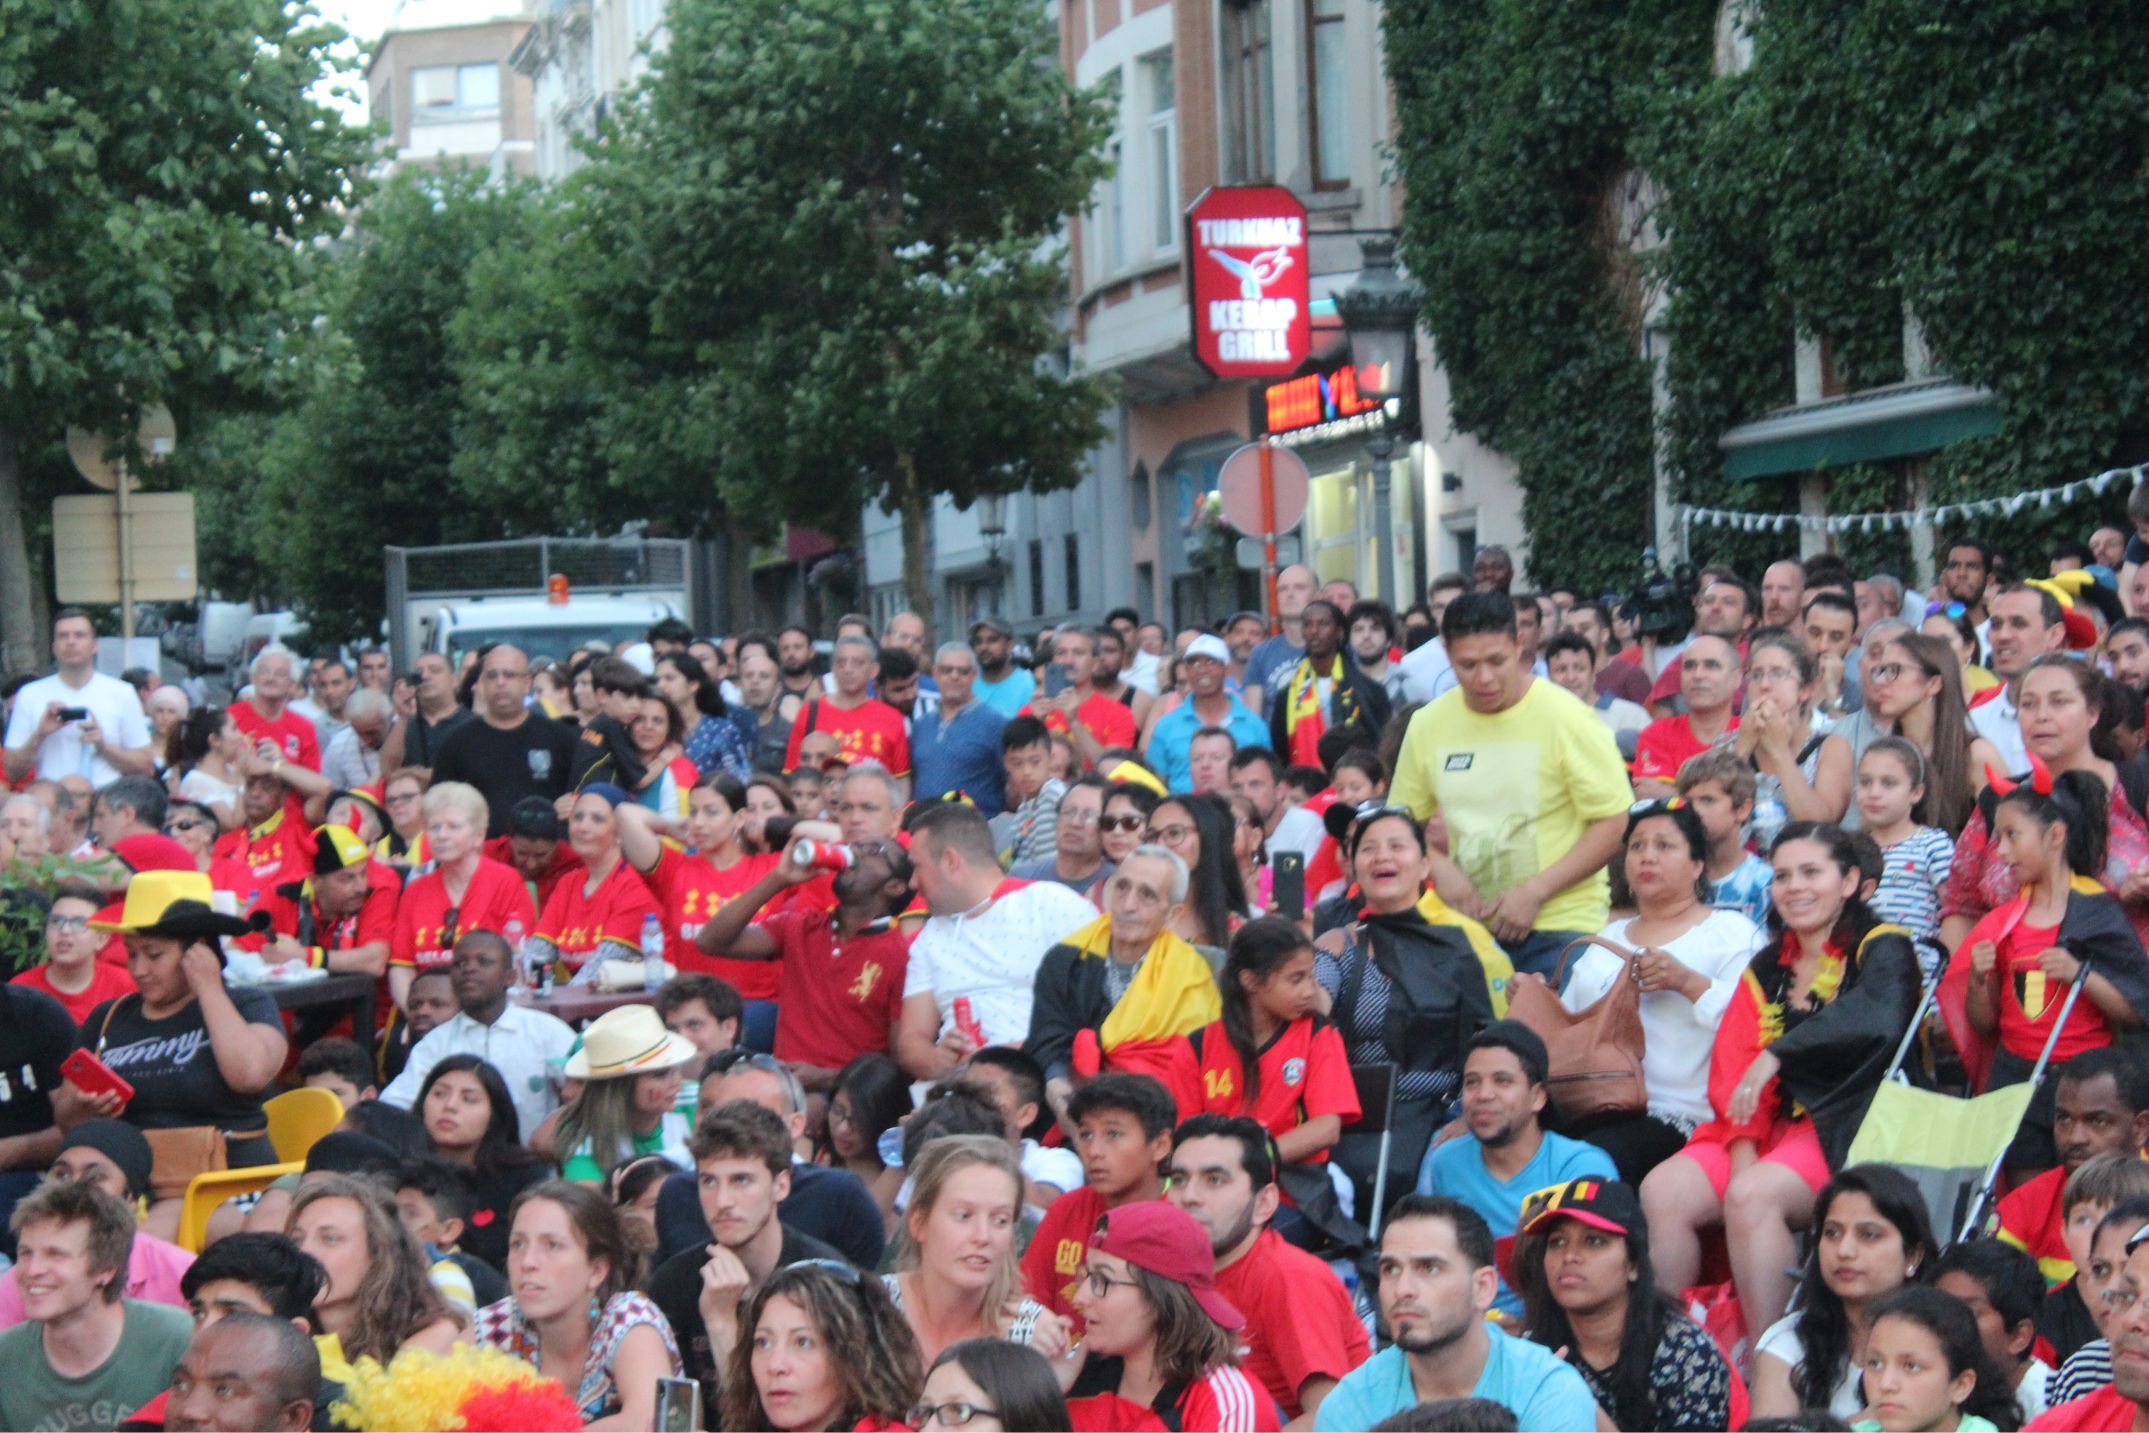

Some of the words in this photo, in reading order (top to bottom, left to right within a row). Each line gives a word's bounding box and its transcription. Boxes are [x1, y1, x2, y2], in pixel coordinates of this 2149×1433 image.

[1209, 298, 1298, 332] KEBAP
[1218, 330, 1291, 362] GRILL
[1204, 1067, 1234, 1099] 14
